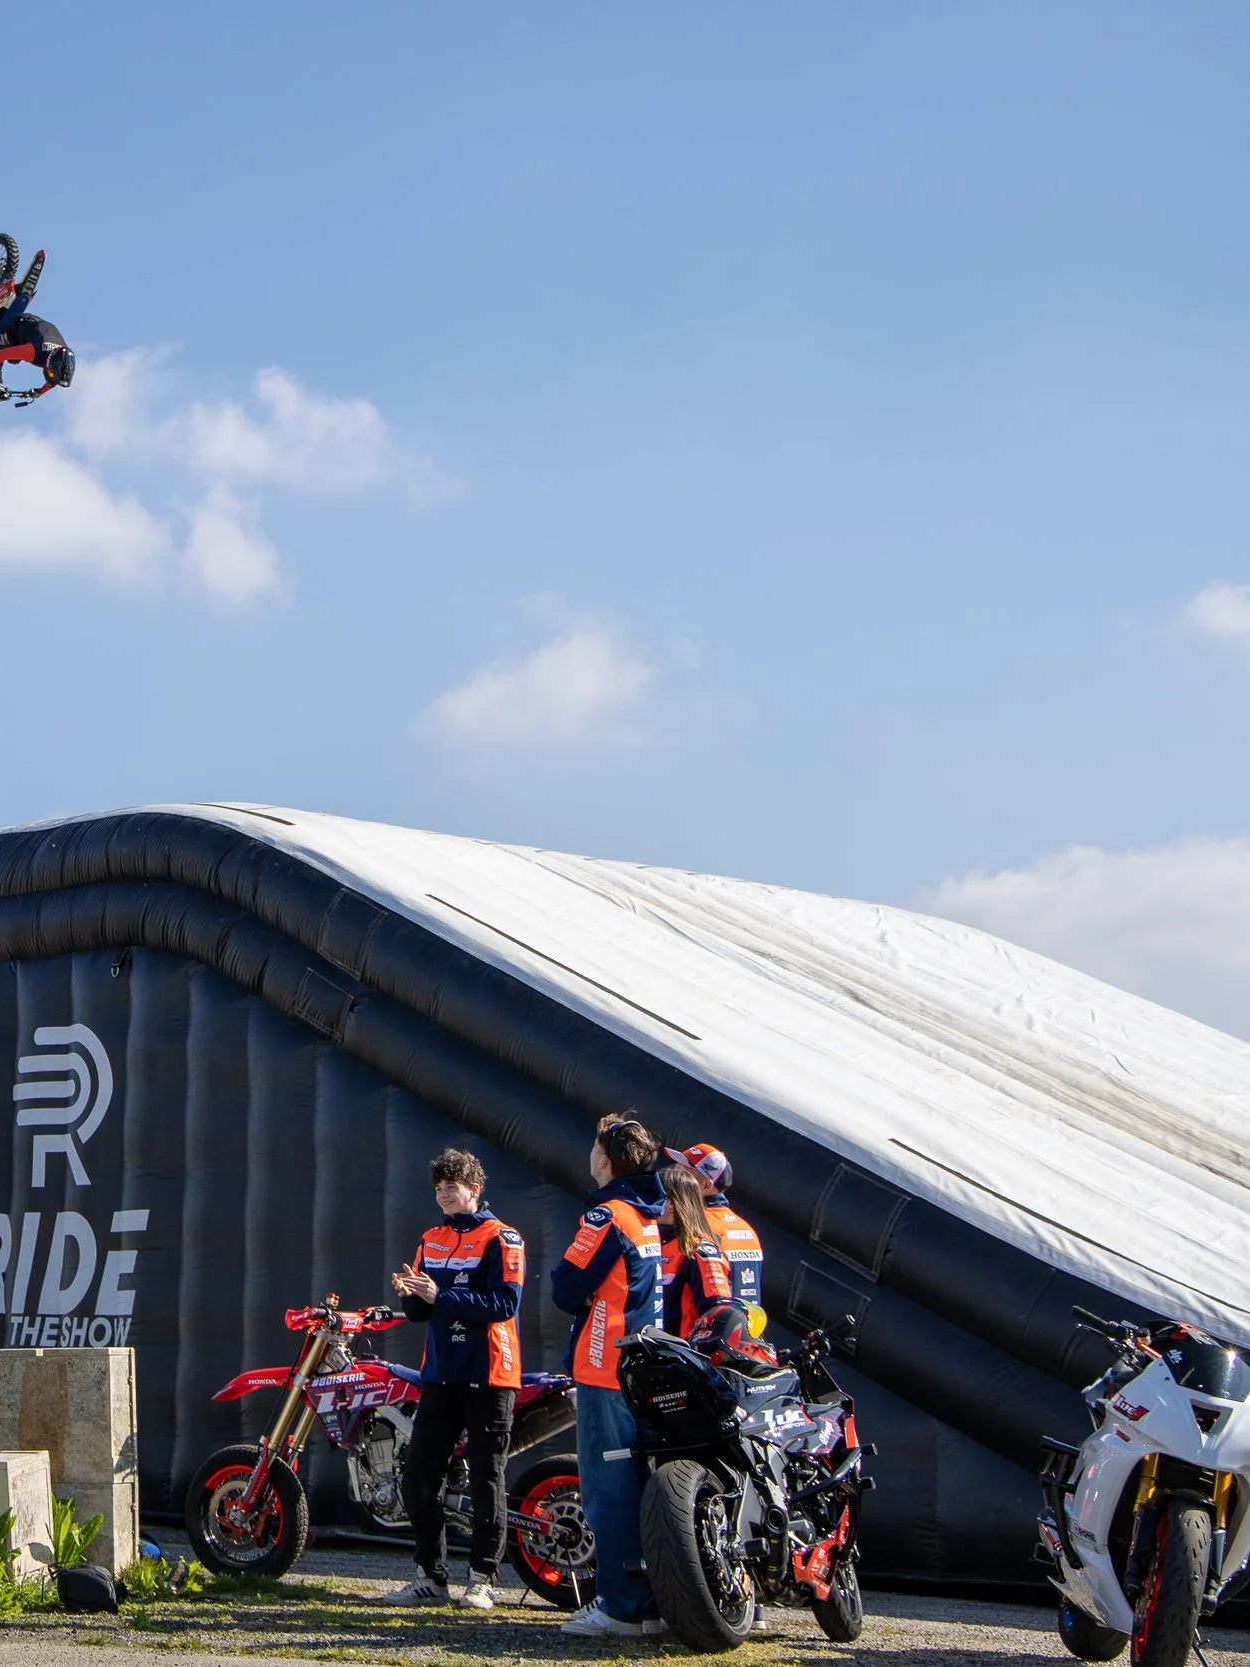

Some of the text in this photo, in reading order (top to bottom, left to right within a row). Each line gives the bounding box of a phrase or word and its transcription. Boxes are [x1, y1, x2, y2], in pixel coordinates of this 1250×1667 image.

[731, 1251, 760, 1260] HONDA
[312, 1372, 366, 1388] #BOISERIE
[354, 1381, 386, 1390] HONDA
